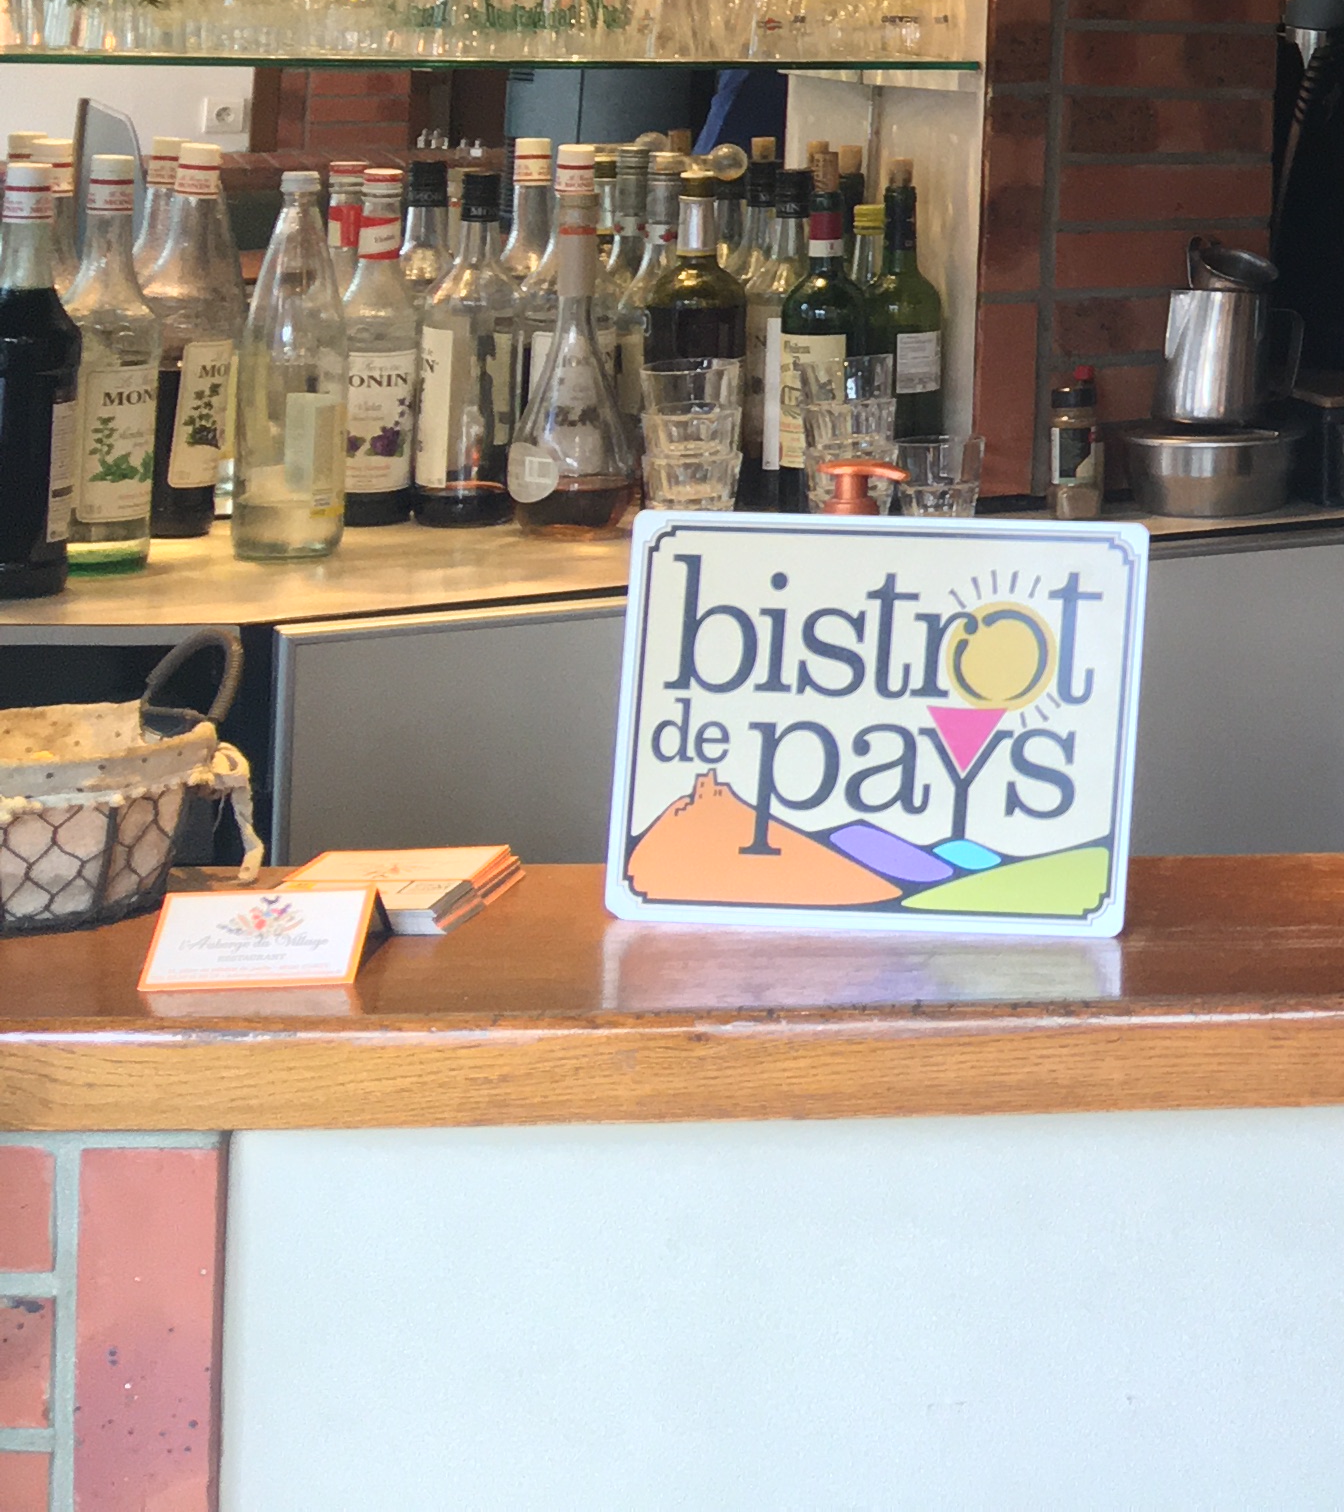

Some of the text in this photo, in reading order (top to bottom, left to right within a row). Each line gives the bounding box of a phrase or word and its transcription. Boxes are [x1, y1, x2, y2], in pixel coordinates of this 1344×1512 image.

[348, 372, 409, 388] ONIN
[663, 554, 1104, 706] bistrot
[650, 697, 1078, 857] de pays
[274, 931, 330, 951] Village
